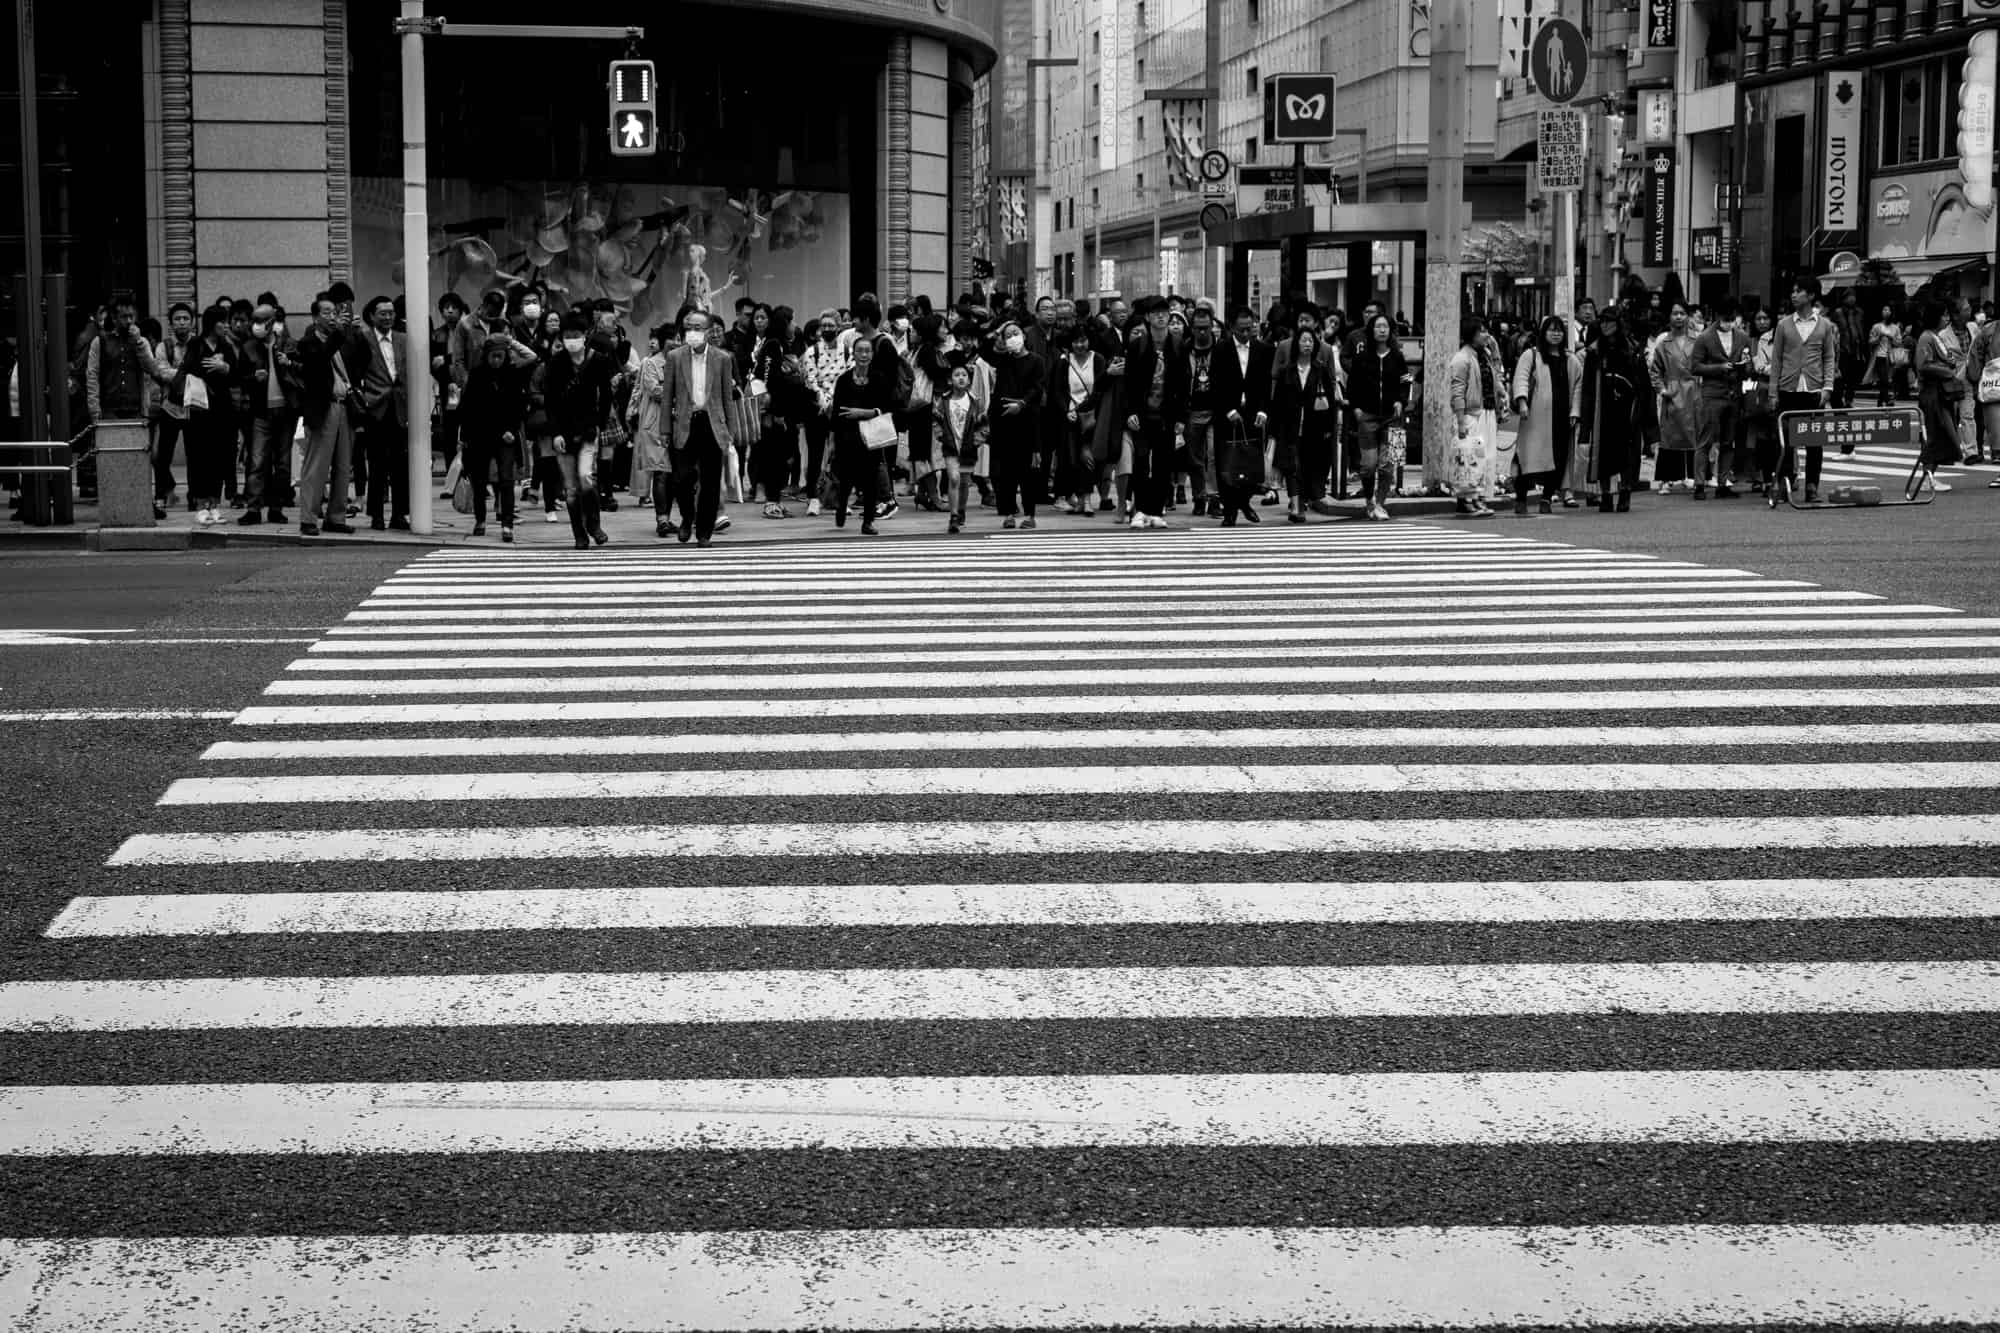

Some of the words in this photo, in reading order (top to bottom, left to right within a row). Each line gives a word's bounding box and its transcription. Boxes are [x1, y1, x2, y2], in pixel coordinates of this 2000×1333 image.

[1264, 189, 1296, 202] 銀座
[1828, 135, 1848, 225] MOTOKI
[1655, 177, 1665, 225] ASSCHER
[1655, 227, 1664, 262] ROYAL
